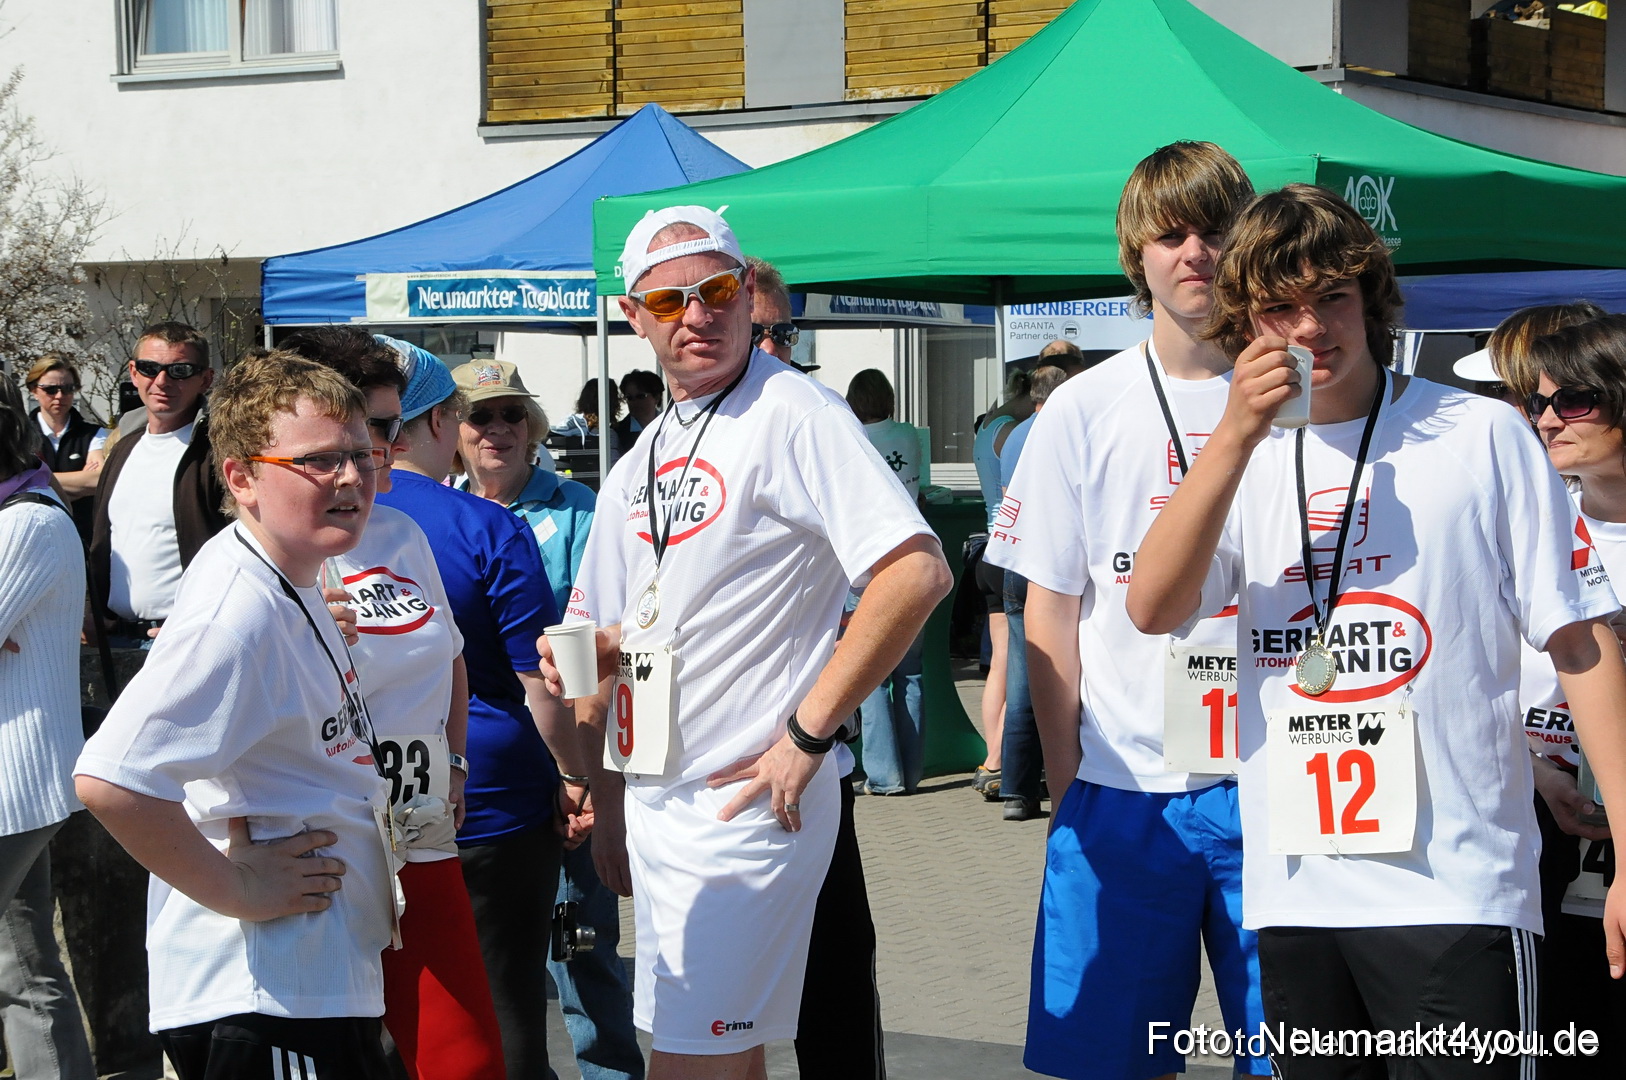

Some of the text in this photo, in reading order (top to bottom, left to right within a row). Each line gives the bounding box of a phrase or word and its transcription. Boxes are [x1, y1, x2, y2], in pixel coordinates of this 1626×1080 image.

[417, 284, 591, 312] Neumarkter Tagblatt
[1010, 321, 1055, 330] GARANTA
[1010, 331, 1058, 340] Partner des
[1284, 554, 1391, 583] SEAT
[1188, 656, 1237, 671] MEYE
[1187, 670, 1238, 682] WERBUN
[617, 683, 635, 757] 9
[1288, 713, 1352, 732] MEYER
[1288, 731, 1353, 745] WERBUNG
[1306, 749, 1379, 835] 12
